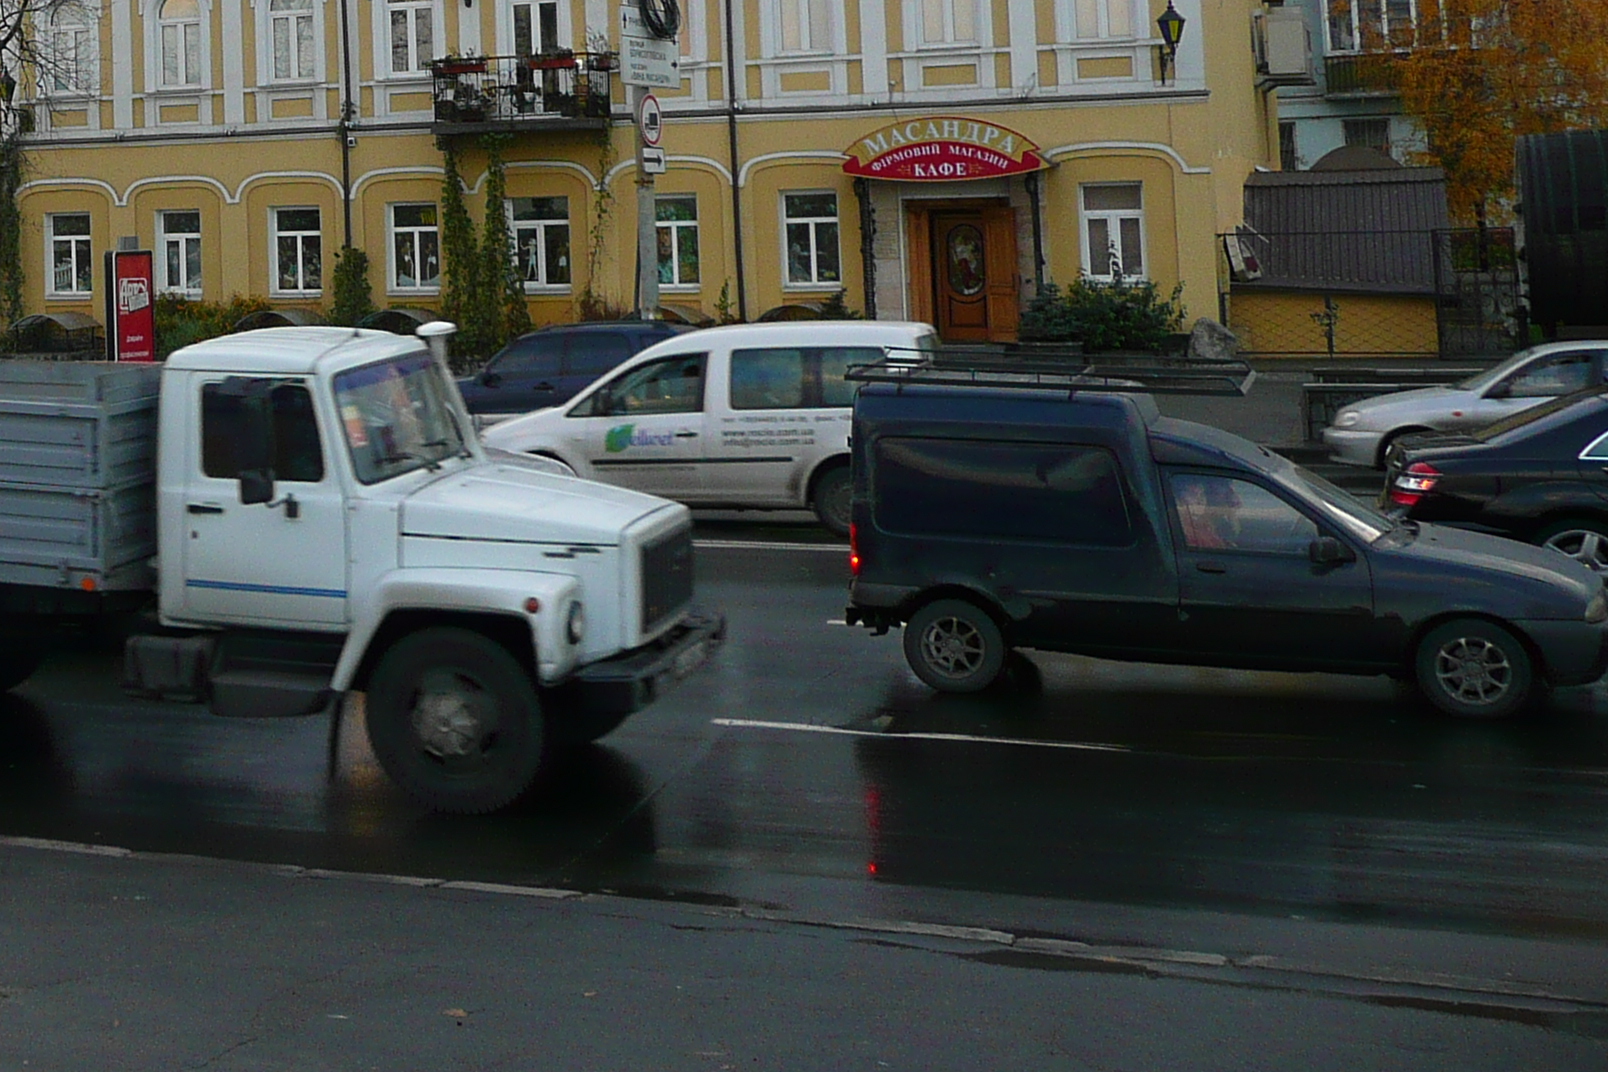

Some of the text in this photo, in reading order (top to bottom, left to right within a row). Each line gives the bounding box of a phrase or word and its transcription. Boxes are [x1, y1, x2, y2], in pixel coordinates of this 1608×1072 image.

[863, 120, 1014, 156] МАСАНДРА
[871, 144, 1009, 172] ФІРМОВИЙ МАГАЗИН
[914, 162, 968, 177] КАФЕ
